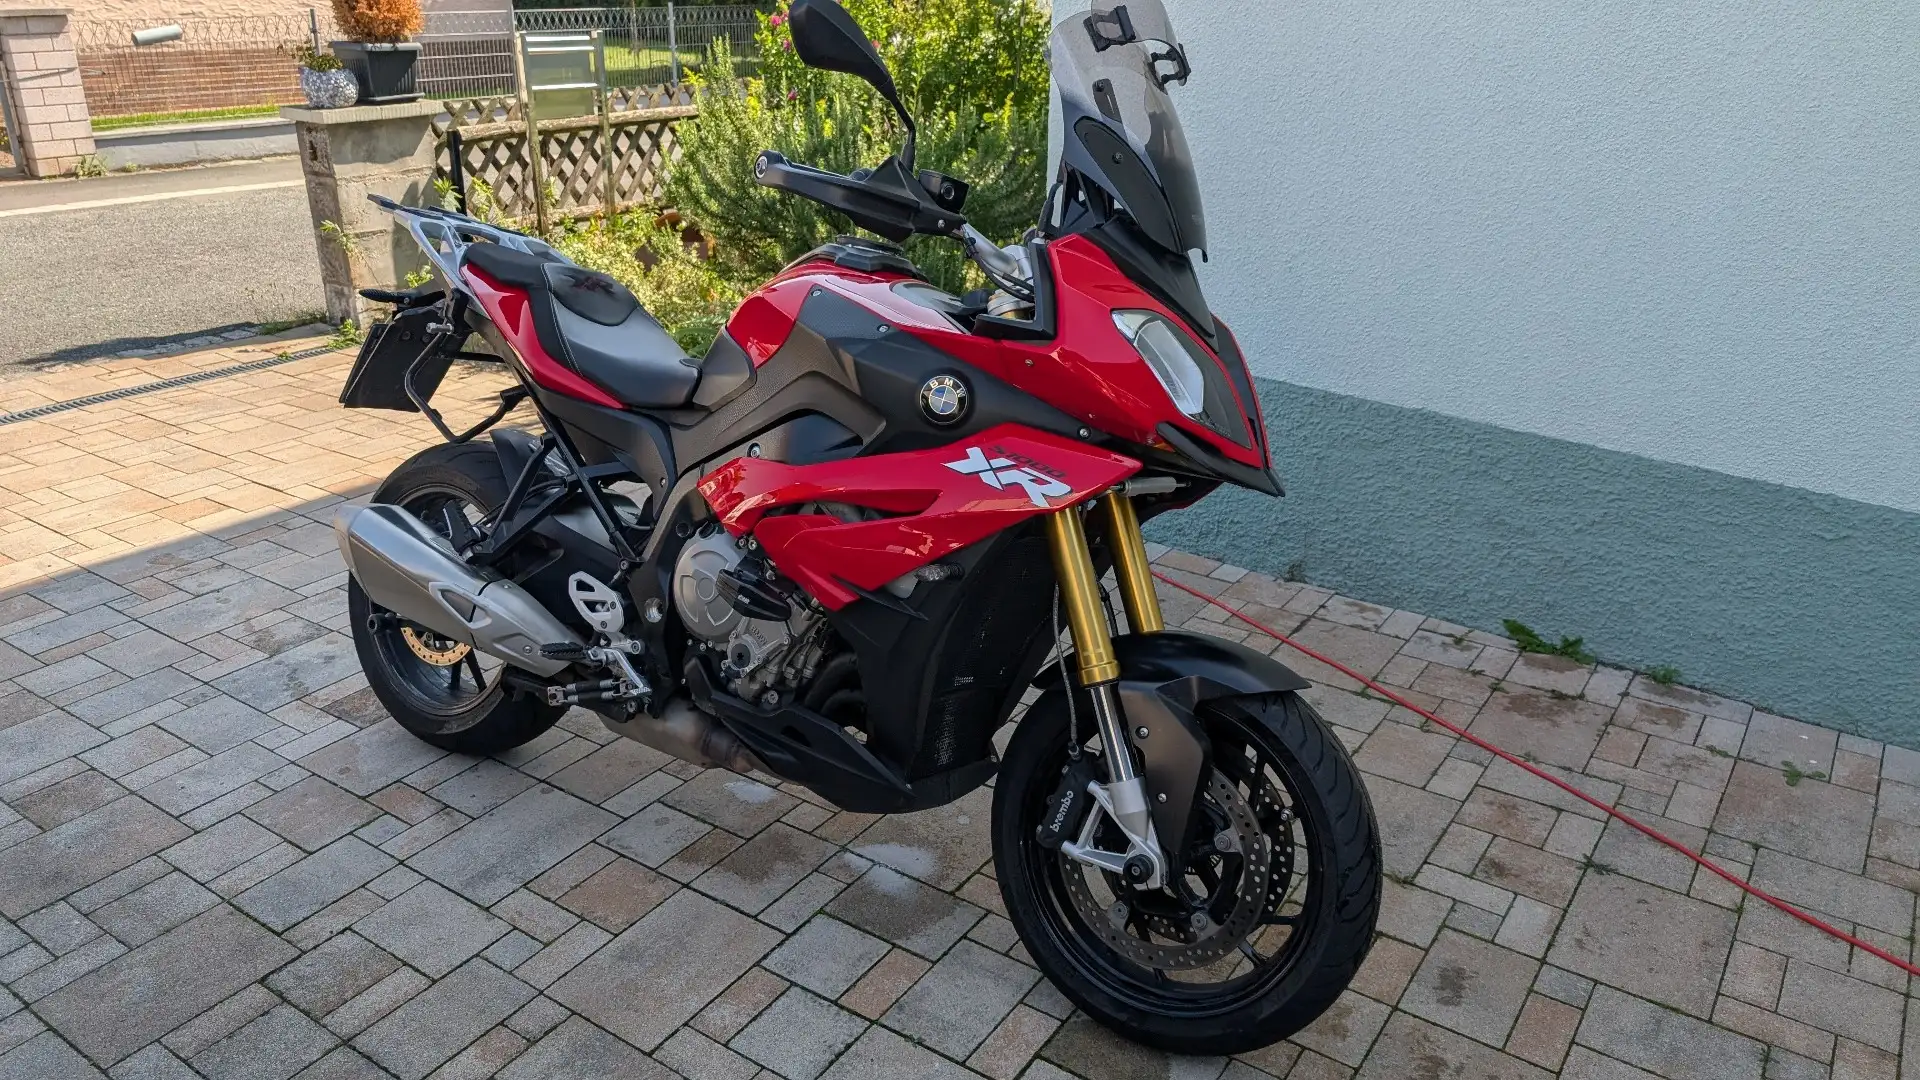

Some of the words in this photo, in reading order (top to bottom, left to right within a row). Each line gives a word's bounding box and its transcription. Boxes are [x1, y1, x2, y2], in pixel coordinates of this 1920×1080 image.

[928, 377, 967, 398] BMW
[941, 446, 1073, 508] XR
[1006, 453, 1066, 479] 1000
[1049, 790, 1074, 833] brembo
